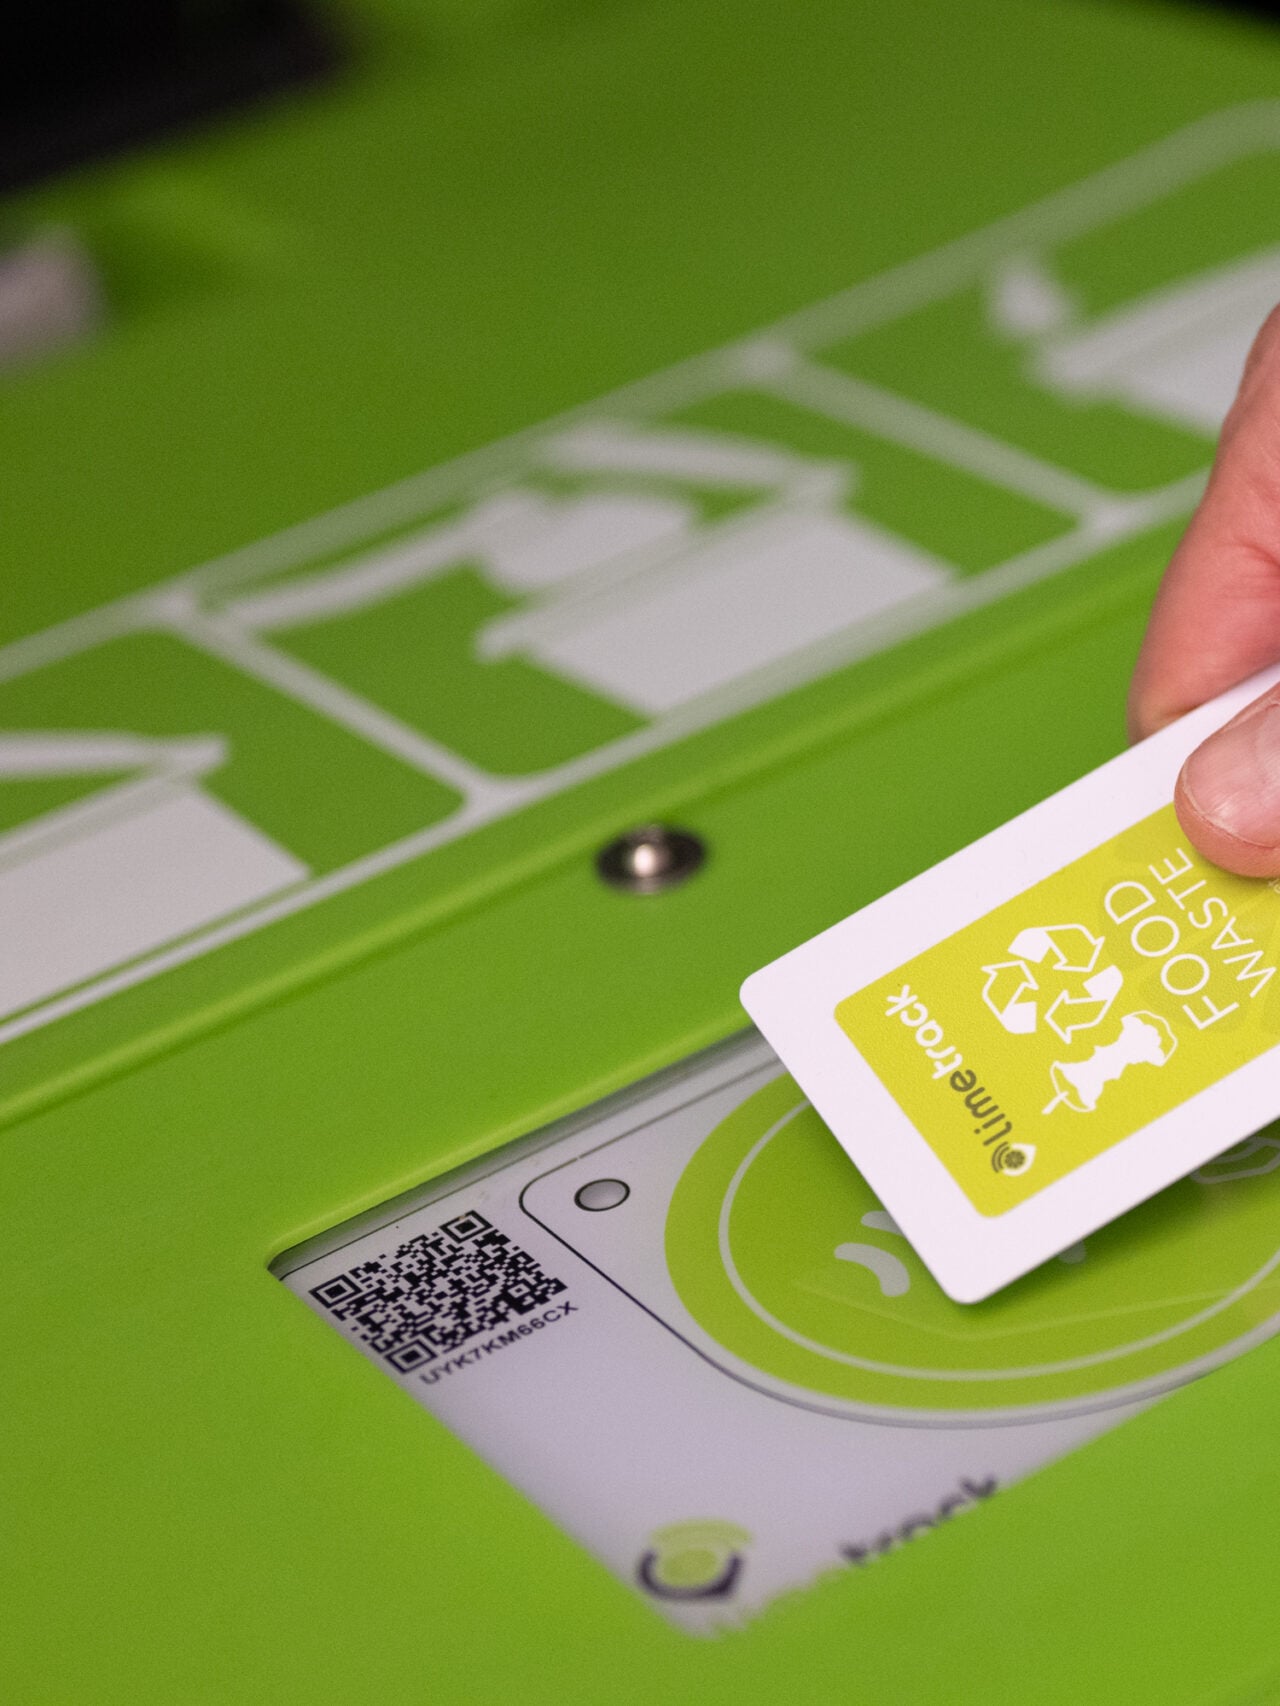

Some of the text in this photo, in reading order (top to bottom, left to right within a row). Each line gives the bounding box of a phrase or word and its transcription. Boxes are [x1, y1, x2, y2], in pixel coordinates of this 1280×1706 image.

[1104, 881, 1239, 1031] FOOD
[1148, 847, 1277, 998] WASTE
[419, 1301, 580, 1385] UYK7KM66CX
